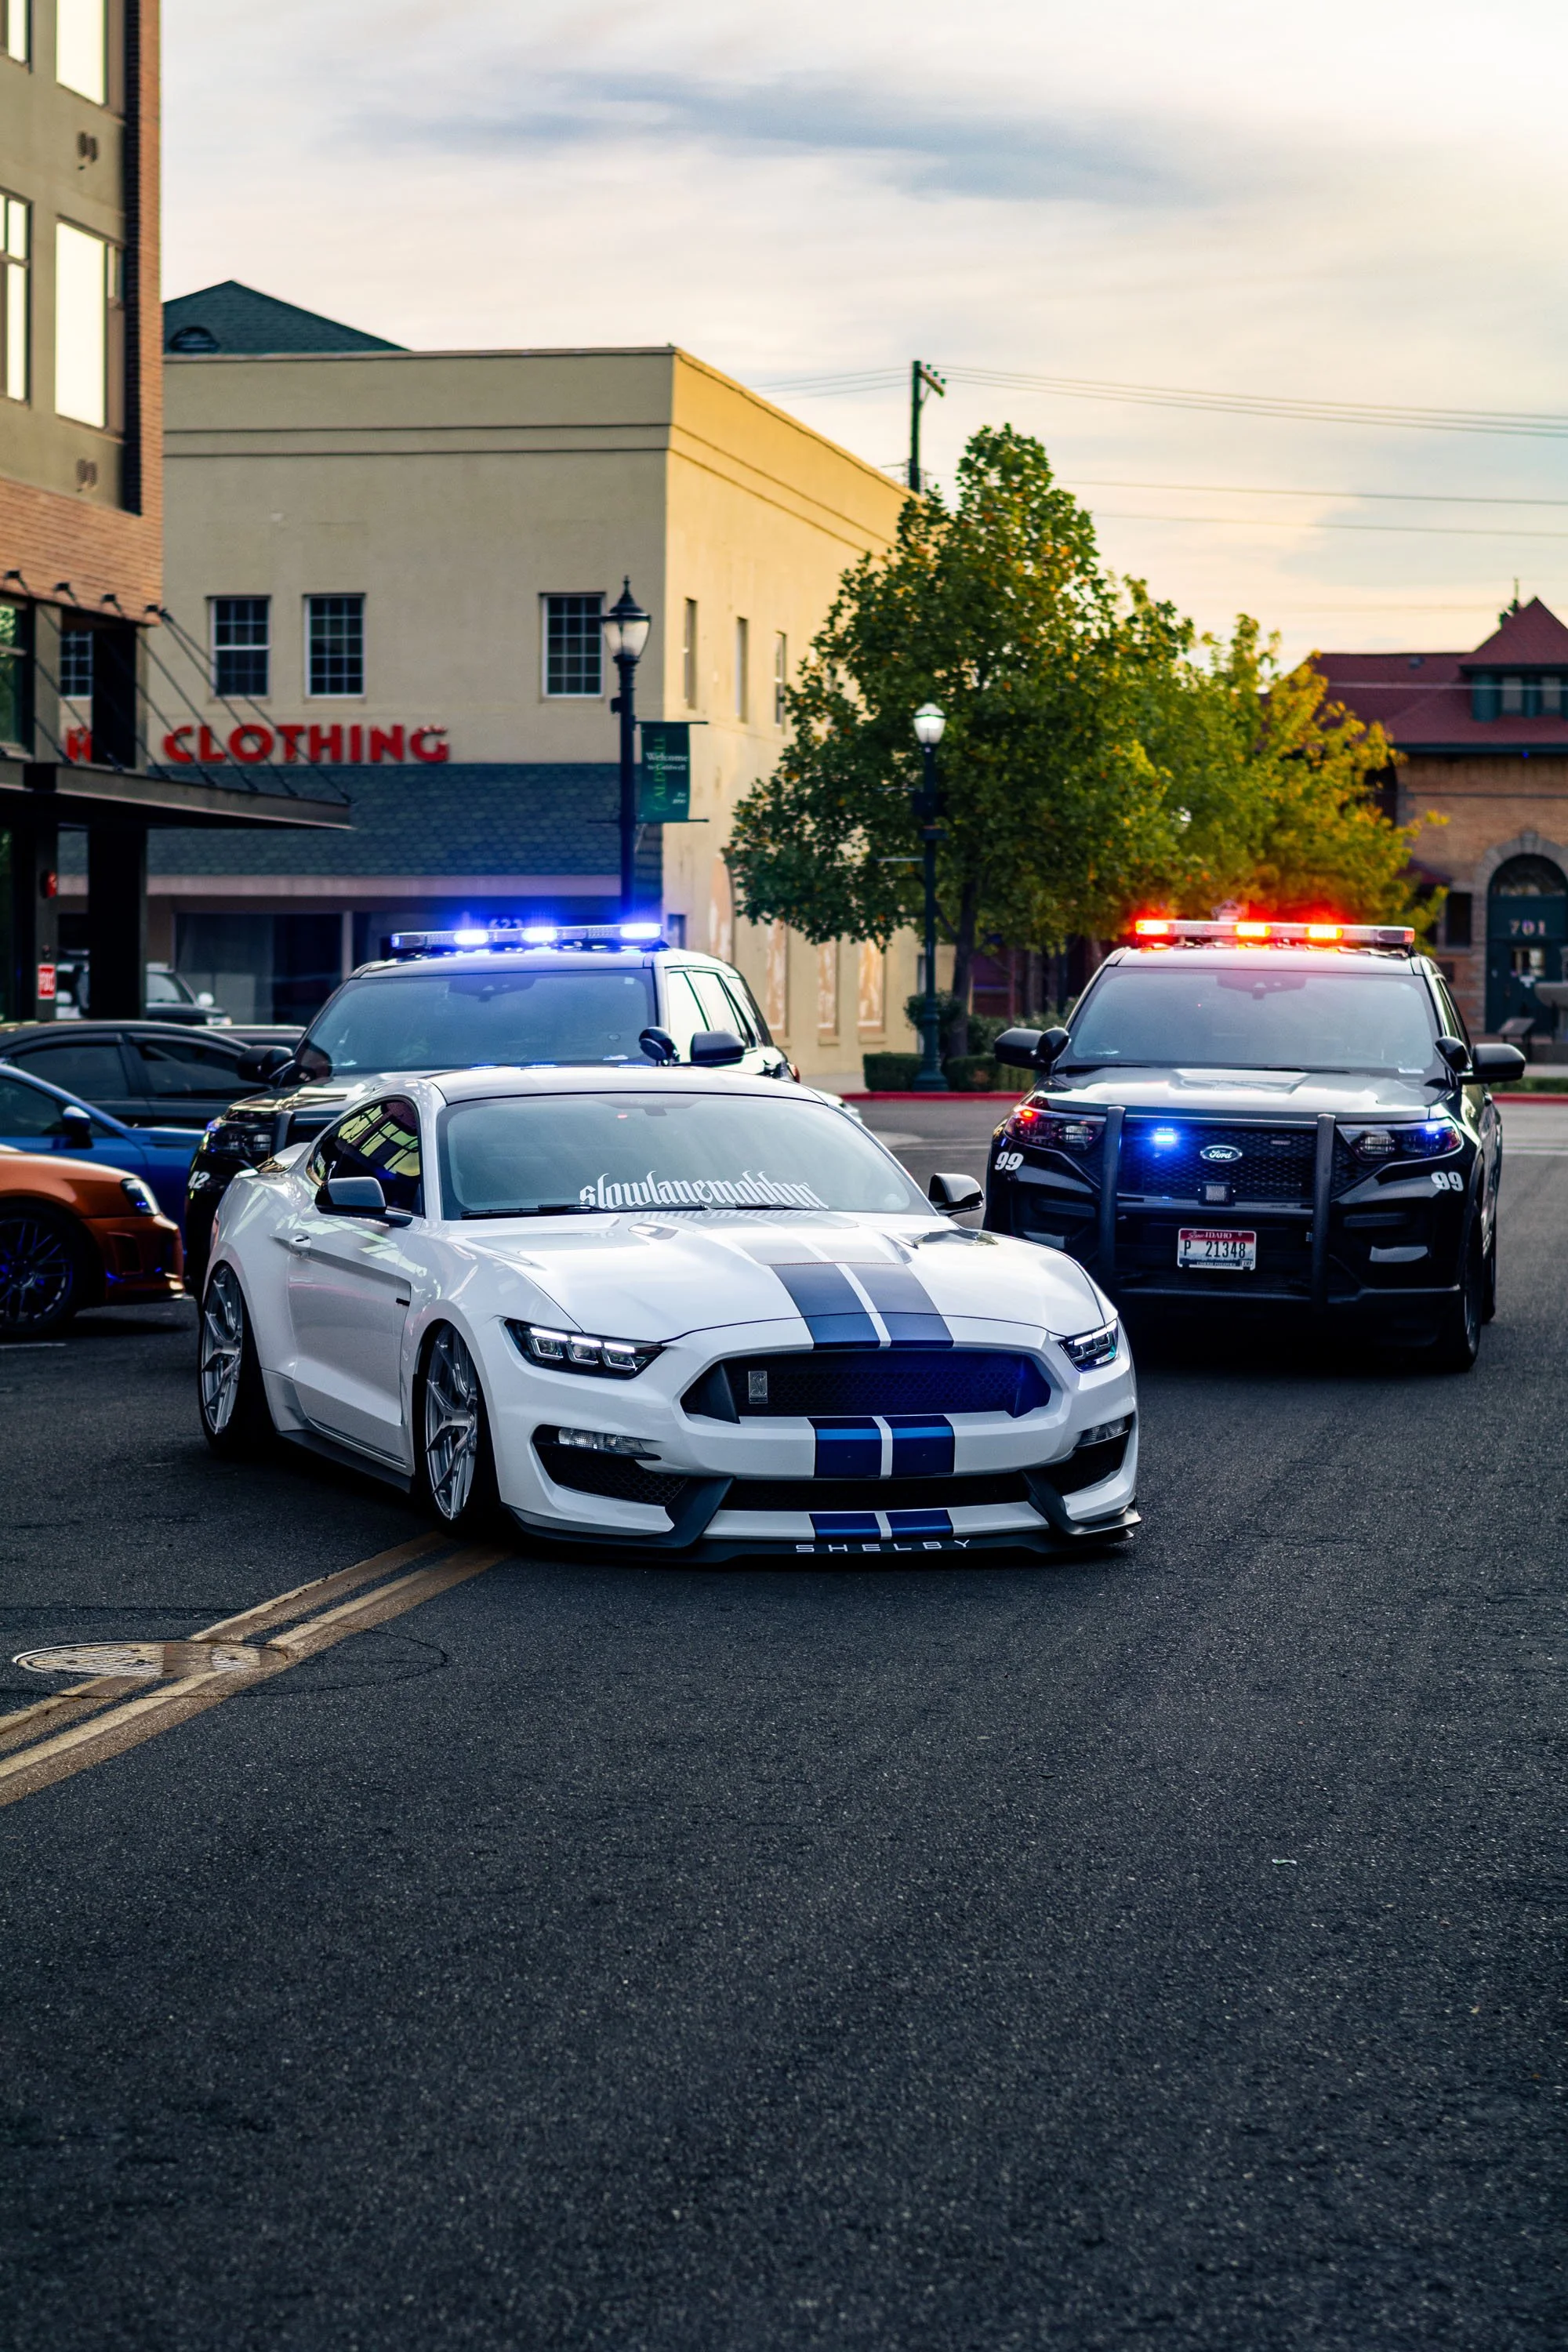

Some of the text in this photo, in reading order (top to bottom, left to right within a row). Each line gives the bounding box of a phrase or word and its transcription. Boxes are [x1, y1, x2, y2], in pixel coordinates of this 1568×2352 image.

[163, 724, 449, 764] CLOTHING
[646, 753, 688, 761] Welcome
[1509, 920, 1545, 936] 701
[995, 1152, 1024, 1171] 99
[1209, 1150, 1232, 1159] Ford
[1431, 1171, 1464, 1192] 99
[1184, 1240, 1246, 1258] P 21348
[796, 1539, 970, 1552] SHELBY
